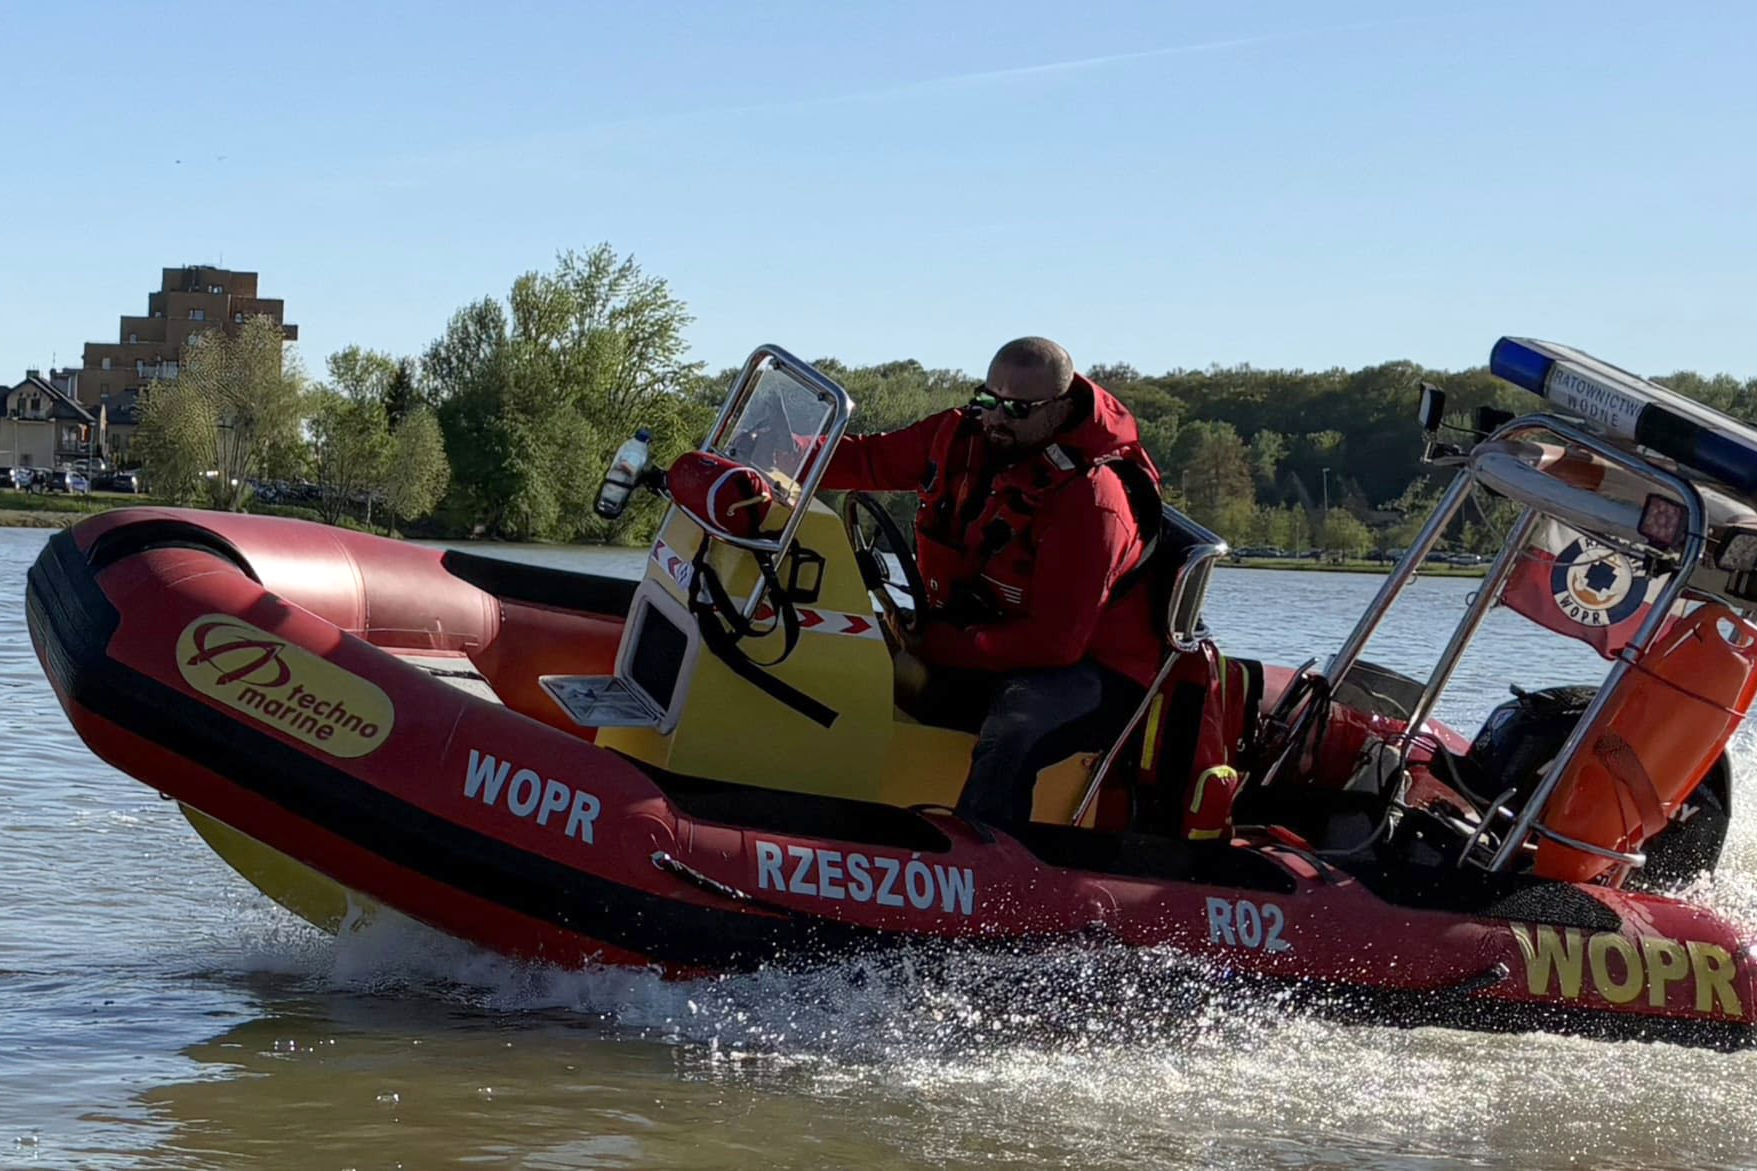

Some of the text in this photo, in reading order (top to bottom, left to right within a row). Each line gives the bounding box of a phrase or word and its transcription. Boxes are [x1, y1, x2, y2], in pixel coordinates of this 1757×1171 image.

[1567, 394, 1619, 427] WODNE
[1560, 595, 1601, 625] WOPR
[238, 687, 334, 740] marine
[287, 684, 378, 738] techno
[464, 749, 600, 844] WOPR
[755, 840, 974, 915] RZESZÓW
[1206, 897, 1291, 952] R02
[1510, 921, 1743, 1016] WOPR
